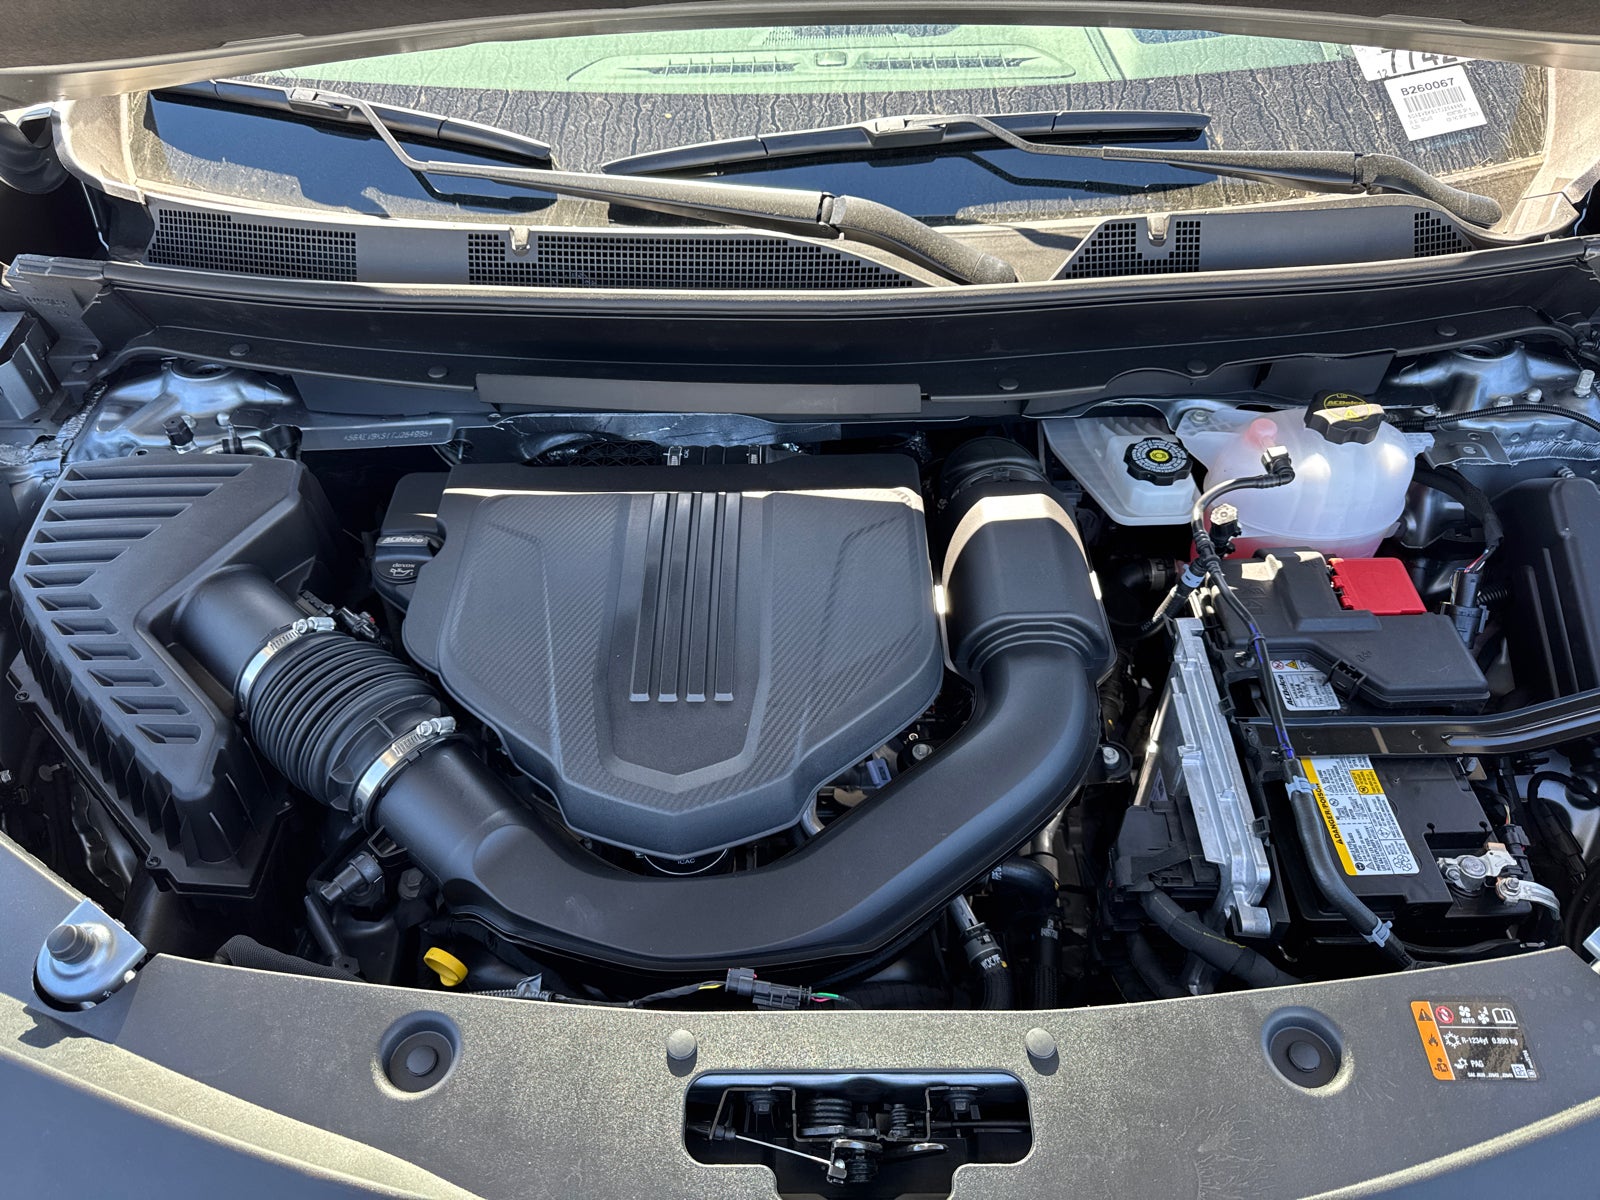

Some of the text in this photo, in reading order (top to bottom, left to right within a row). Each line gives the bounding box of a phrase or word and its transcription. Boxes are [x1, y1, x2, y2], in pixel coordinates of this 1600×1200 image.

[1400, 77, 1455, 96] B260067
[1461, 1036, 1489, 1046] R-1234yf
[1470, 1060, 1484, 1068] PAG
